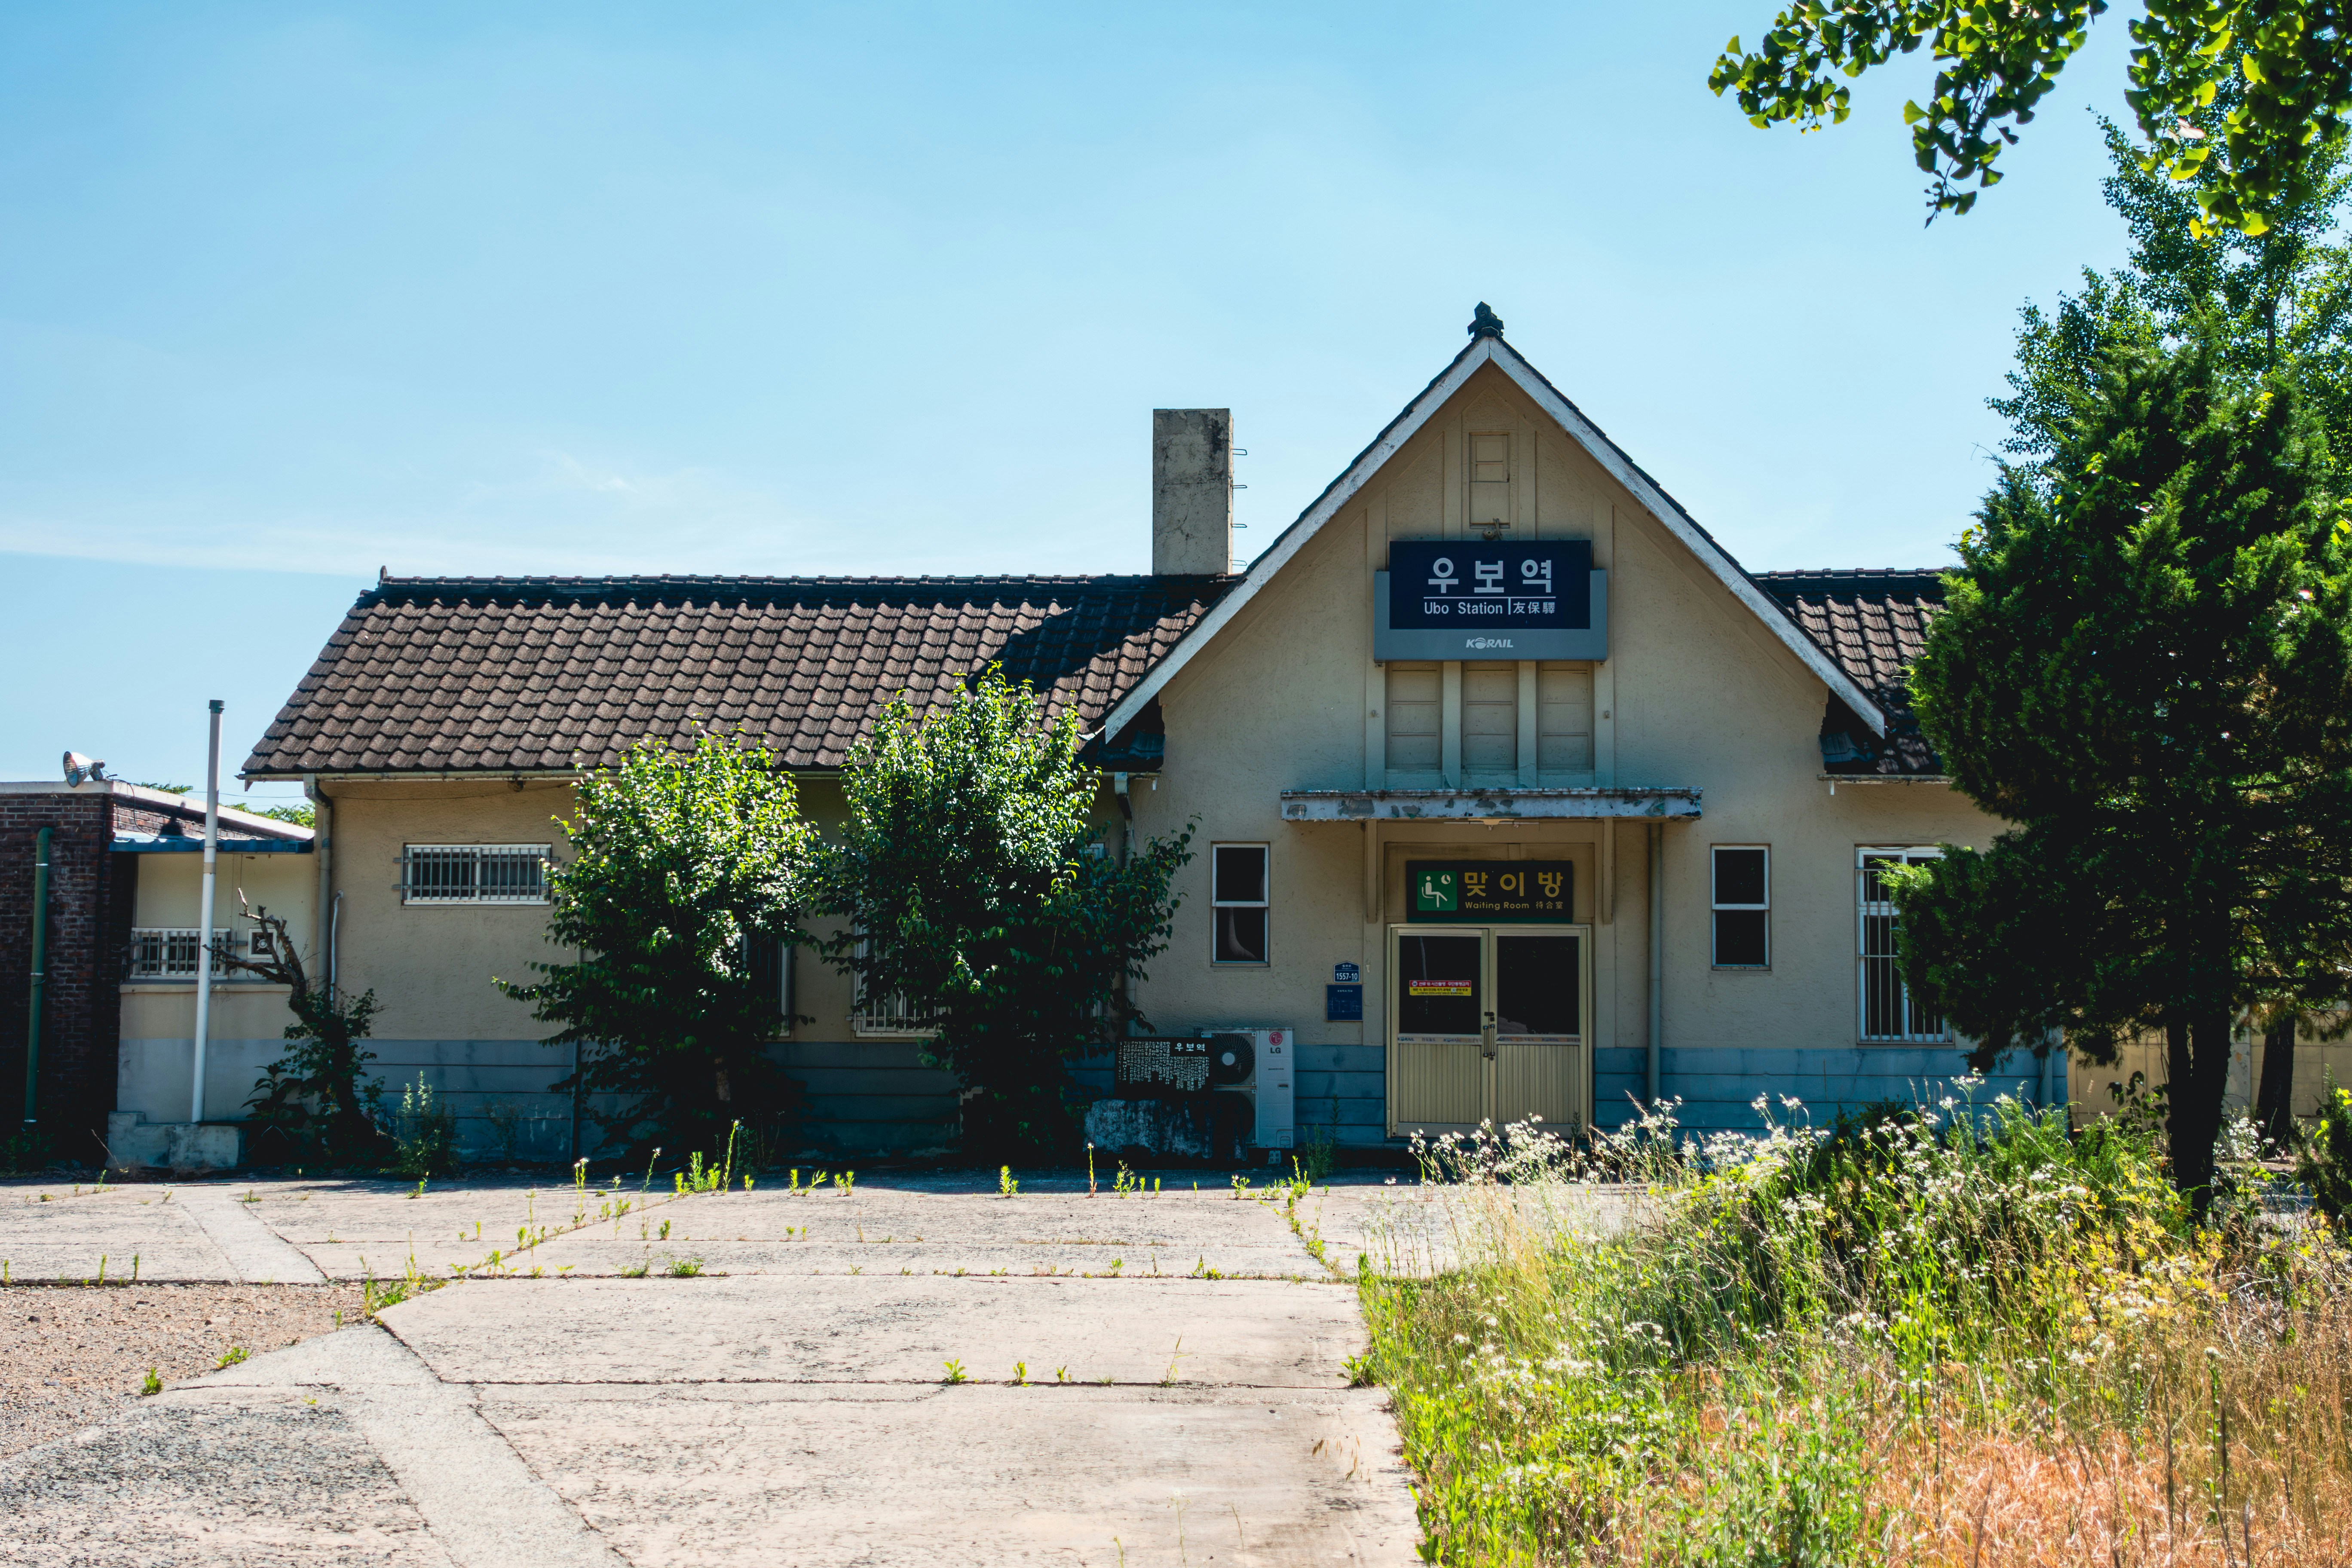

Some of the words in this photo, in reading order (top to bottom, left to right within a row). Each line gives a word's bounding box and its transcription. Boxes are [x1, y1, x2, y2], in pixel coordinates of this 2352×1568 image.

[1428, 557, 1552, 594] 우보역
[1424, 602, 1449, 614] Ubo
[1458, 602, 1503, 614] Station
[1513, 601, 1555, 614] 友保驛
[1466, 637, 1513, 649] KORAIL
[1464, 871, 1563, 897] 맞이방
[1465, 901, 1500, 910] Waiting
[1536, 901, 1563, 909] 待合室
[1175, 1043, 1205, 1052] 우보역
